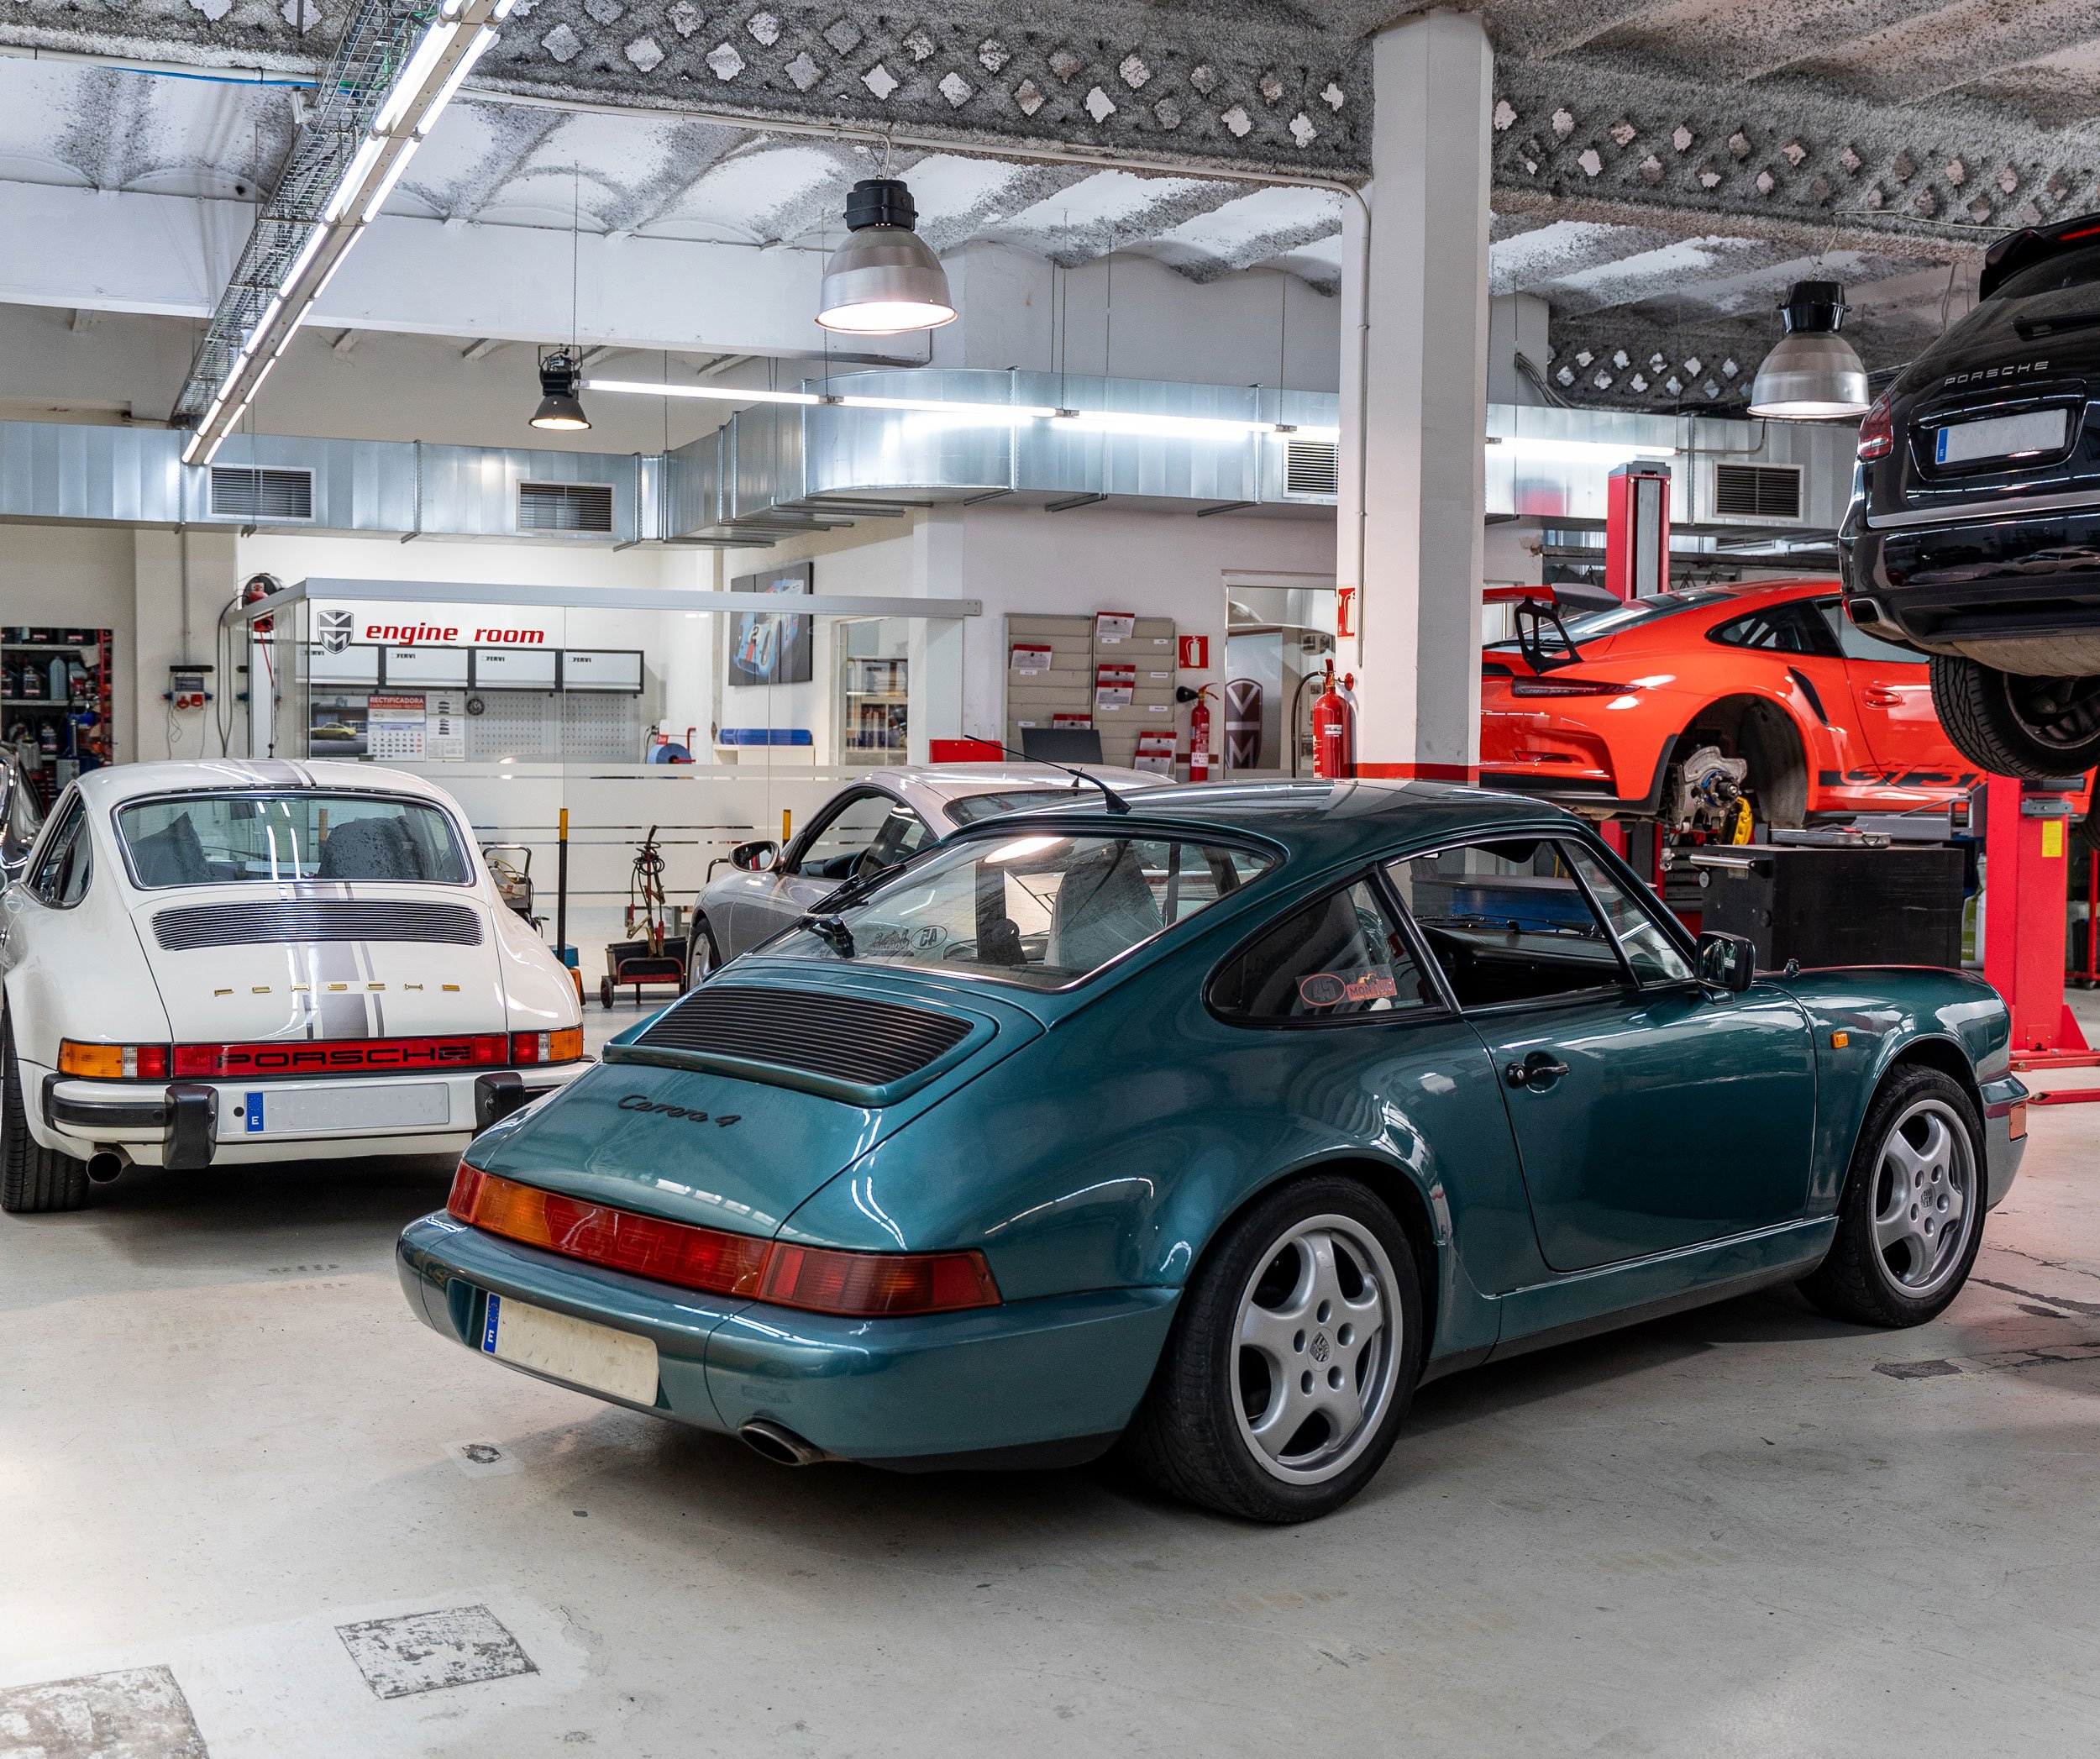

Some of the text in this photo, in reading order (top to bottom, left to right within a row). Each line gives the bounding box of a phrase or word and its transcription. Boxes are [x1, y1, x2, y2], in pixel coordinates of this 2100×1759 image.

[1944, 360, 2050, 387] PORSCHE
[1939, 448, 1945, 458] E
[365, 622, 544, 646] engine room
[214, 983, 461, 997] PORSCHE
[216, 1045, 471, 1069] PORSCHE
[617, 1094, 742, 1127] Carrera 4
[251, 1116, 260, 1126] E
[487, 1329, 495, 1343] E
